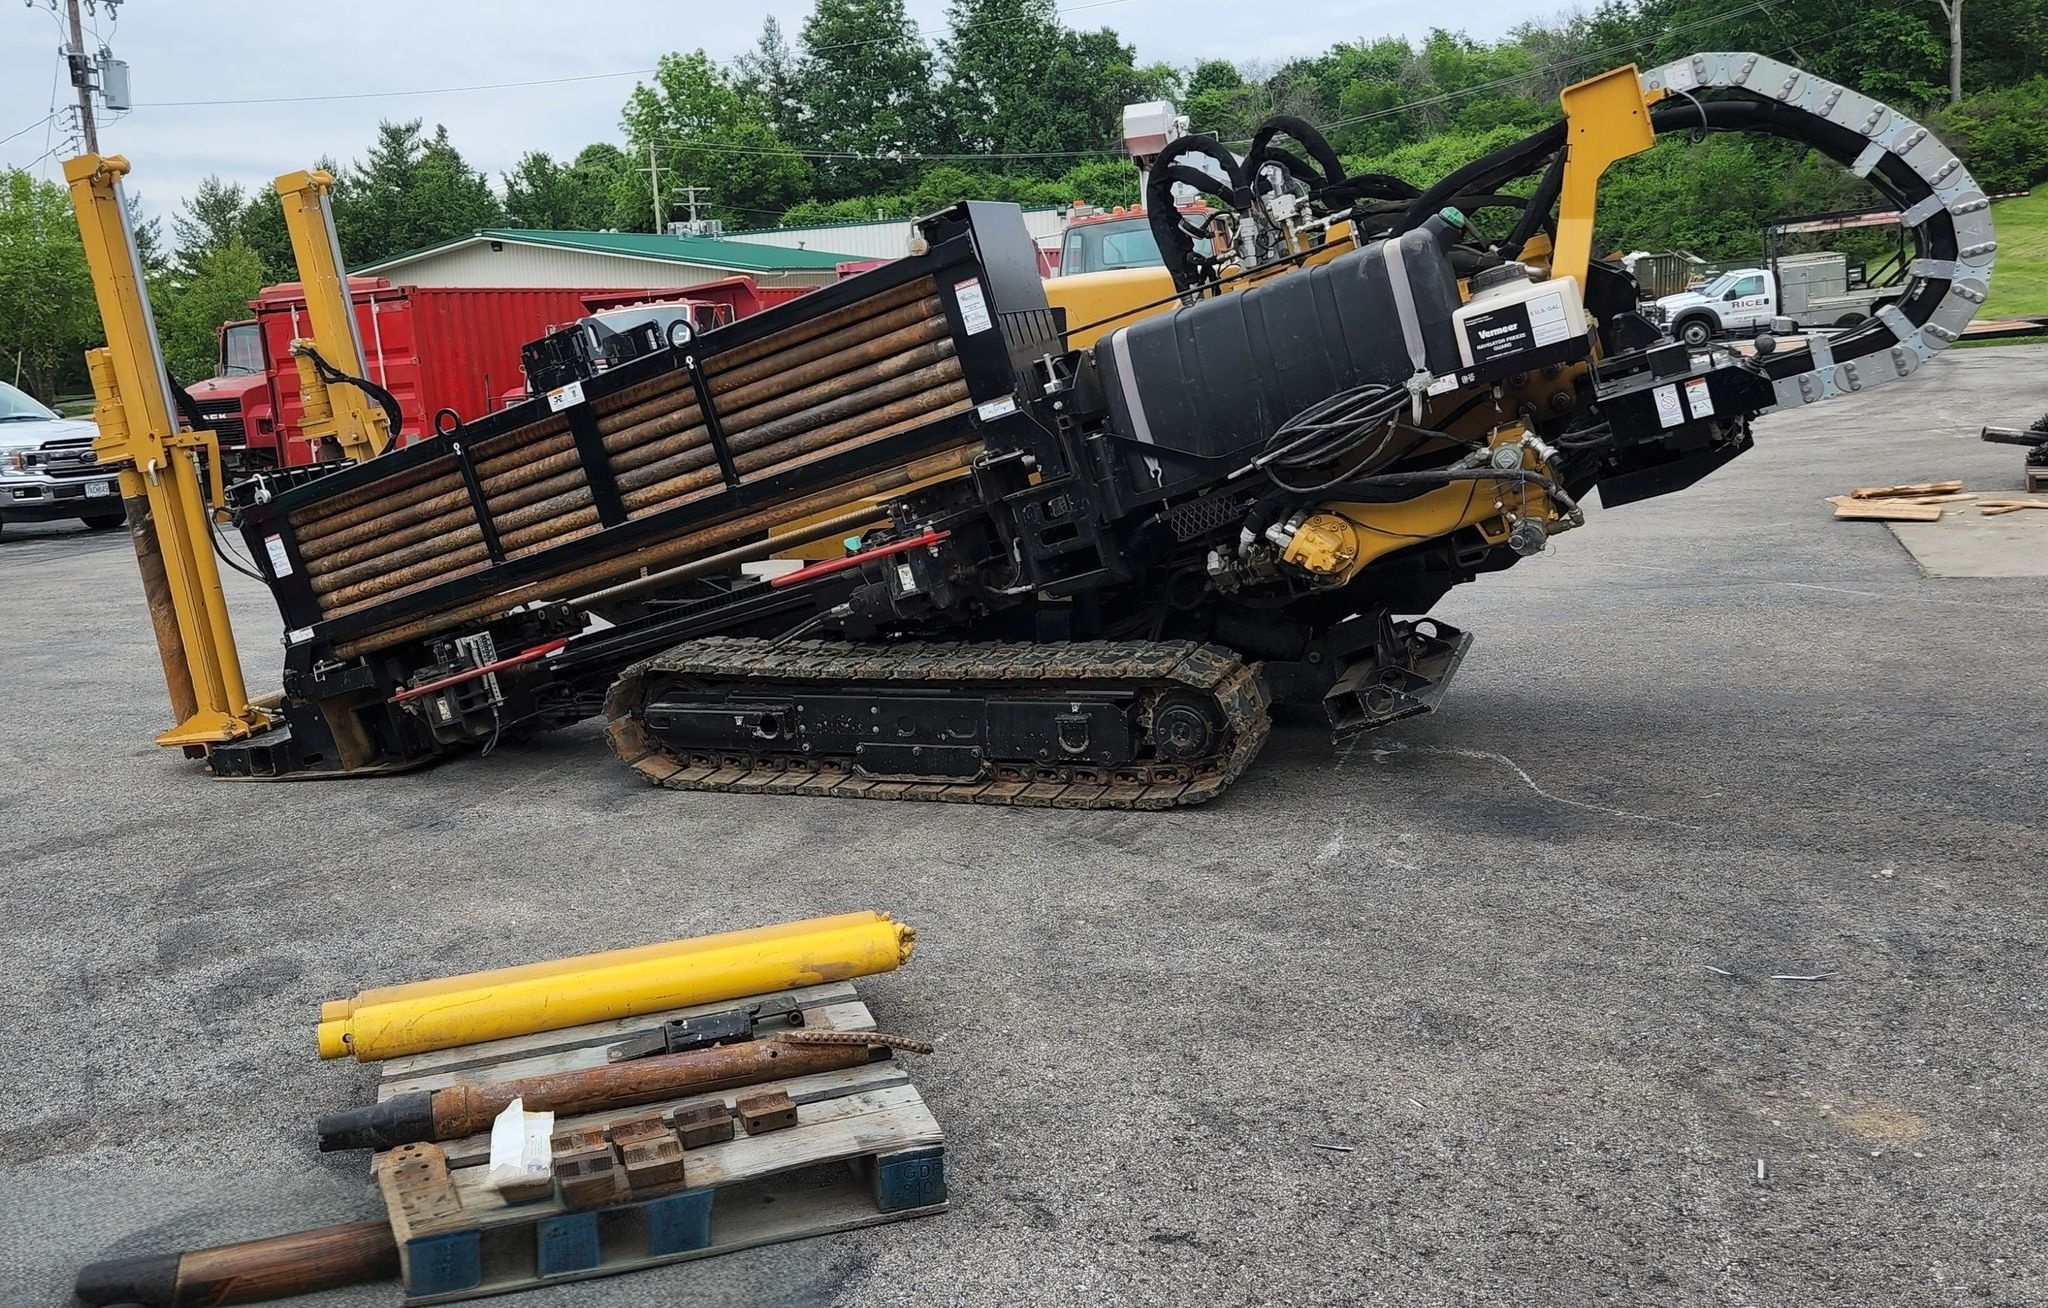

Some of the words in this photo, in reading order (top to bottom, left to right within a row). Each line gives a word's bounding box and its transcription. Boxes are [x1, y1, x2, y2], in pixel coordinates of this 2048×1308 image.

[1732, 299, 1763, 308] RICE
[1478, 323, 1518, 339] Vermeer
[1476, 338, 1506, 350] NAVIGATOR
[1506, 332, 1527, 343] FREEZE
[1493, 342, 1512, 351] GUARD
